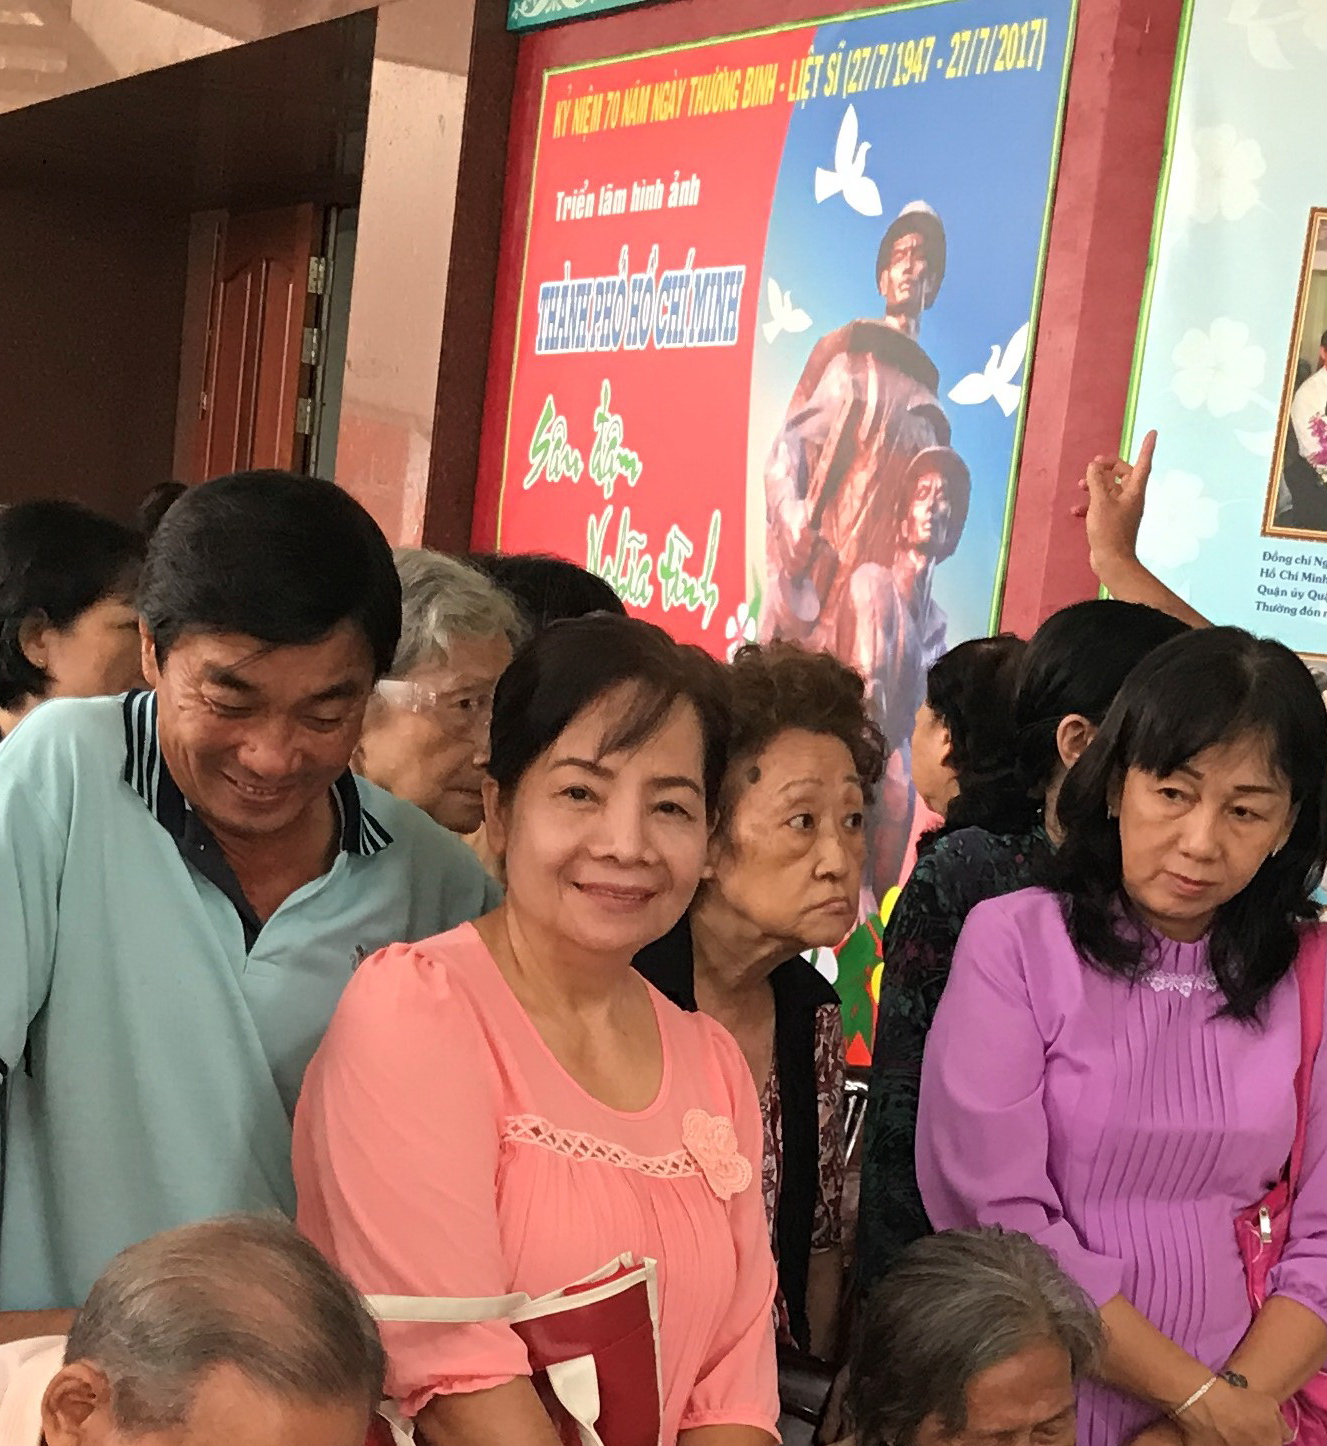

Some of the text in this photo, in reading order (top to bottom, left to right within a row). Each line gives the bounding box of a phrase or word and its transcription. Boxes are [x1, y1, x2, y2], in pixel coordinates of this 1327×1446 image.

[571, 84, 604, 142] NIỆM
[603, 91, 621, 130] 70
[741, 63, 778, 109] BINH
[787, 44, 824, 109] LIỆT
[824, 39, 846, 96] SĨ
[843, 35, 936, 99] (27/7/1947
[946, 18, 1048, 79] 27/7/2017)
[556, 170, 701, 222] Triển lãm hình ảnh
[535, 244, 746, 355] THÀNH PHỐ HỒ CHÍ MINH
[1263, 551, 1292, 565] Đồng
[1295, 555, 1311, 565] chí
[1260, 568, 1276, 579] Hồ
[1280, 570, 1298, 581] Chí
[1257, 585, 1288, 598] Quận
[1291, 588, 1305, 600] ủy
[1255, 601, 1297, 617] Thường
[1299, 606, 1320, 618] đón
